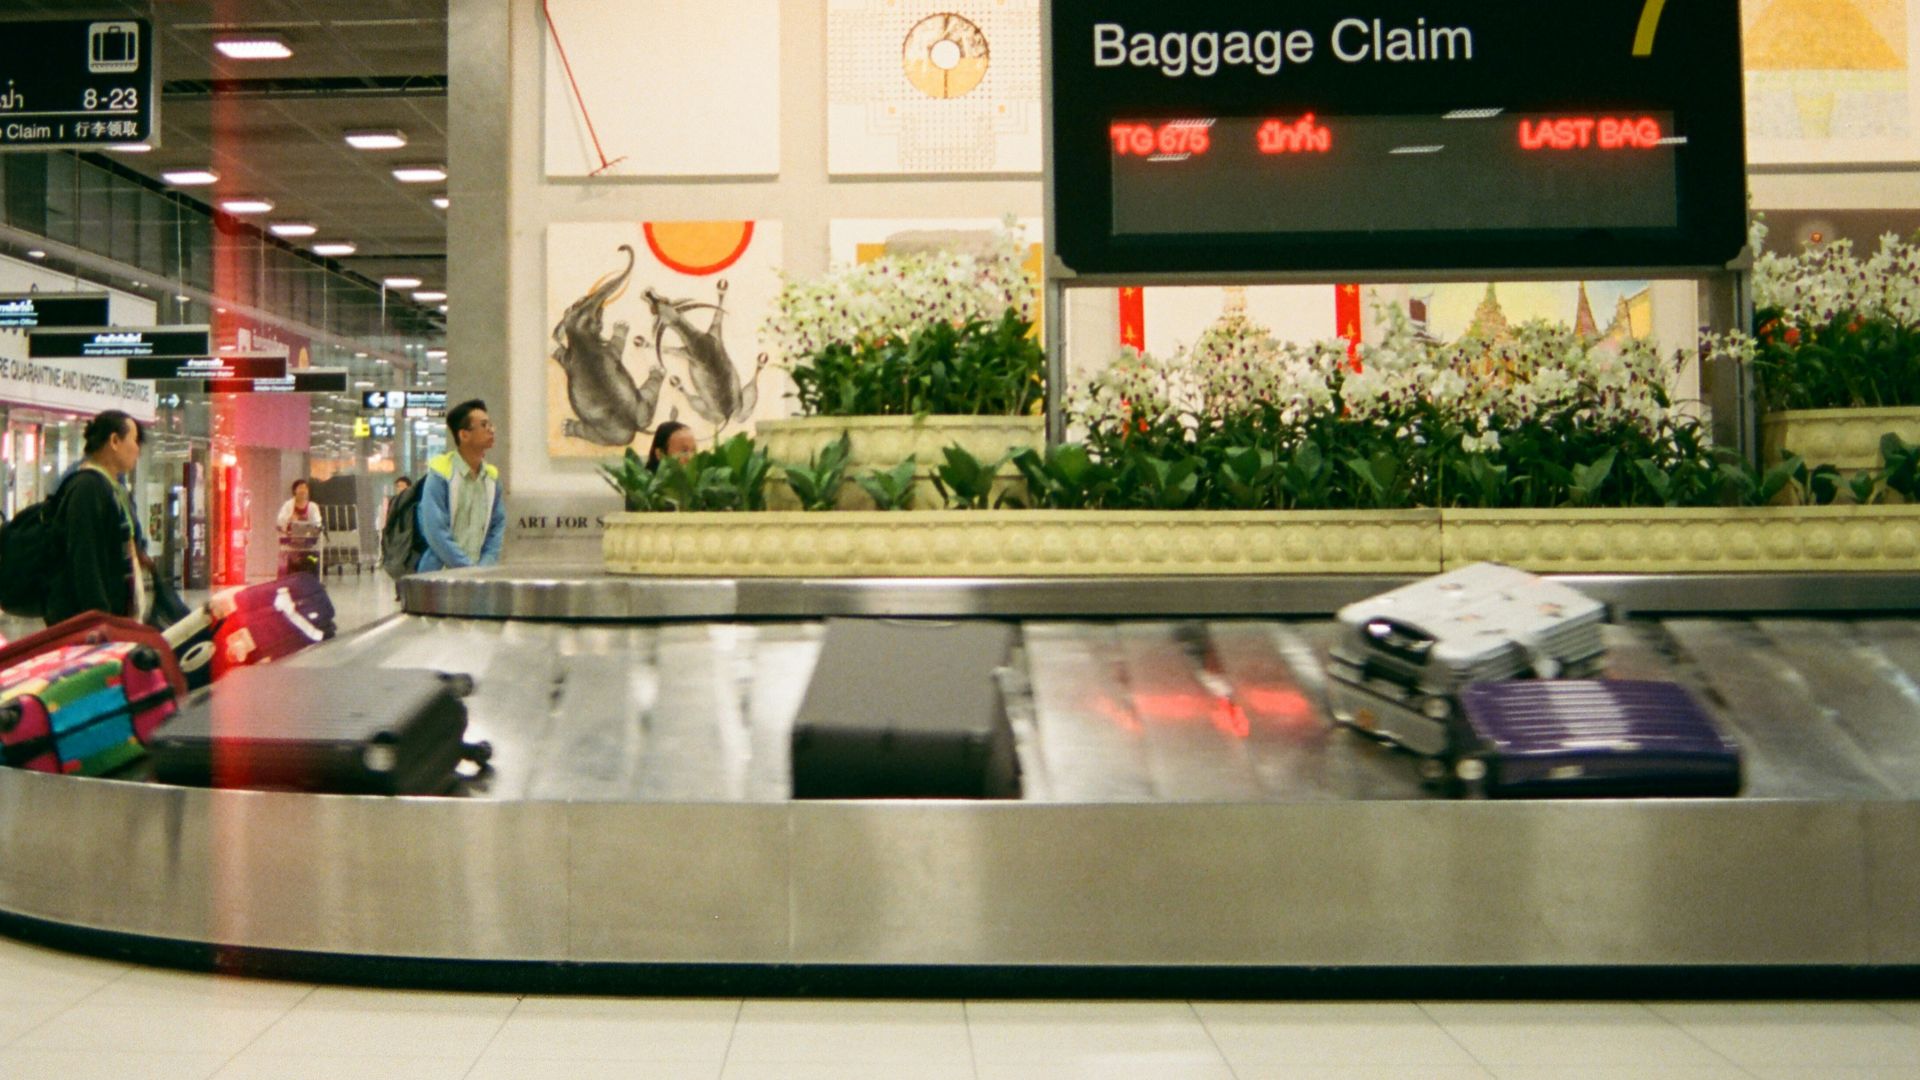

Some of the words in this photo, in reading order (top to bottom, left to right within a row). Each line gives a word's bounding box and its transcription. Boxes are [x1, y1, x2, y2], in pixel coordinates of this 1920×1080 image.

[1093, 22, 1314, 77] Baggage
[1331, 18, 1473, 62] Claim
[83, 87, 138, 110] 8-23
[7, 123, 51, 140] Claim
[75, 120, 138, 138] 行李领取
[1111, 123, 1154, 155] TG
[1157, 121, 1210, 154] 675
[1519, 118, 1595, 150] LAST
[1597, 116, 1661, 150] BAG
[518, 516, 547, 529] ART
[556, 516, 588, 529] FOR
[596, 516, 606, 529] S
